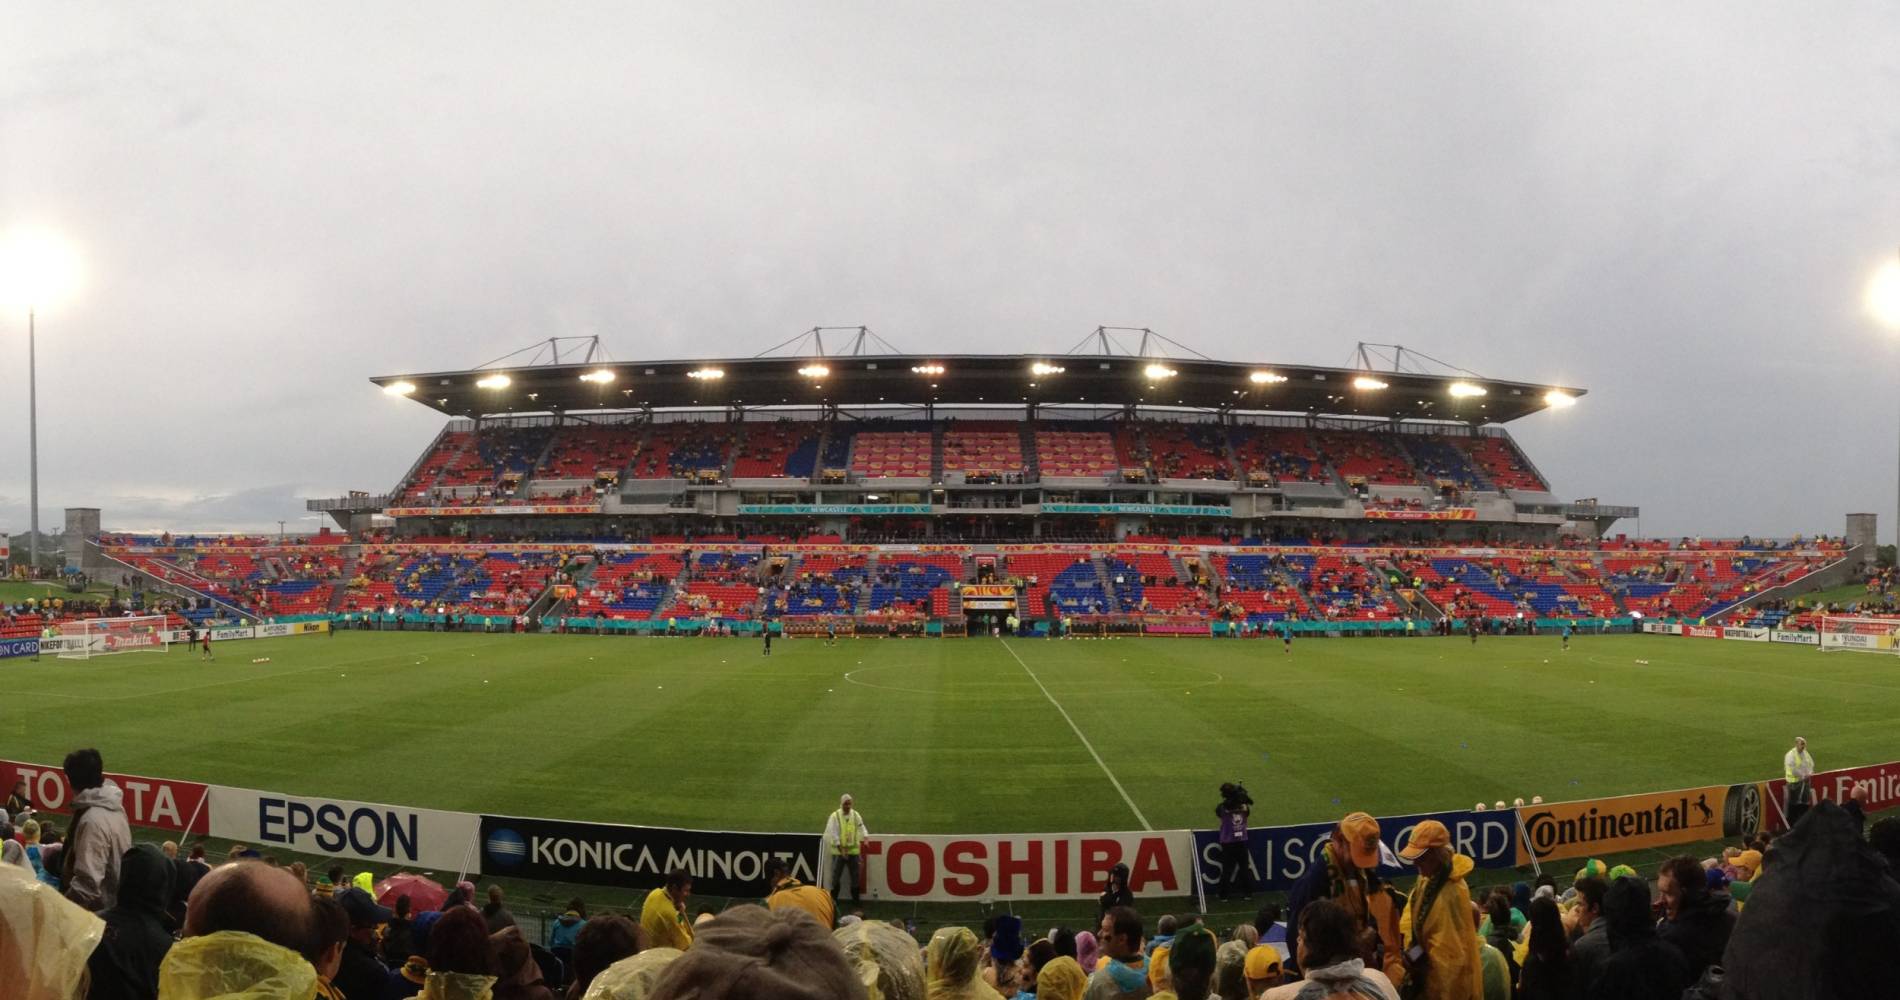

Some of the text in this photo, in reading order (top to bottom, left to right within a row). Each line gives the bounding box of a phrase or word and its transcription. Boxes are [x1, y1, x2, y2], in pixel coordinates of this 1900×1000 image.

[216, 630, 248, 640] FamilyMart
[303, 623, 320, 632] Nikon
[1776, 632, 1813, 643] FamilyMart
[12, 641, 38, 655] CARD
[16, 767, 182, 826] TOTA
[259, 797, 418, 861] EPSON
[1522, 798, 1689, 858] Continental
[531, 836, 659, 874] KONICA
